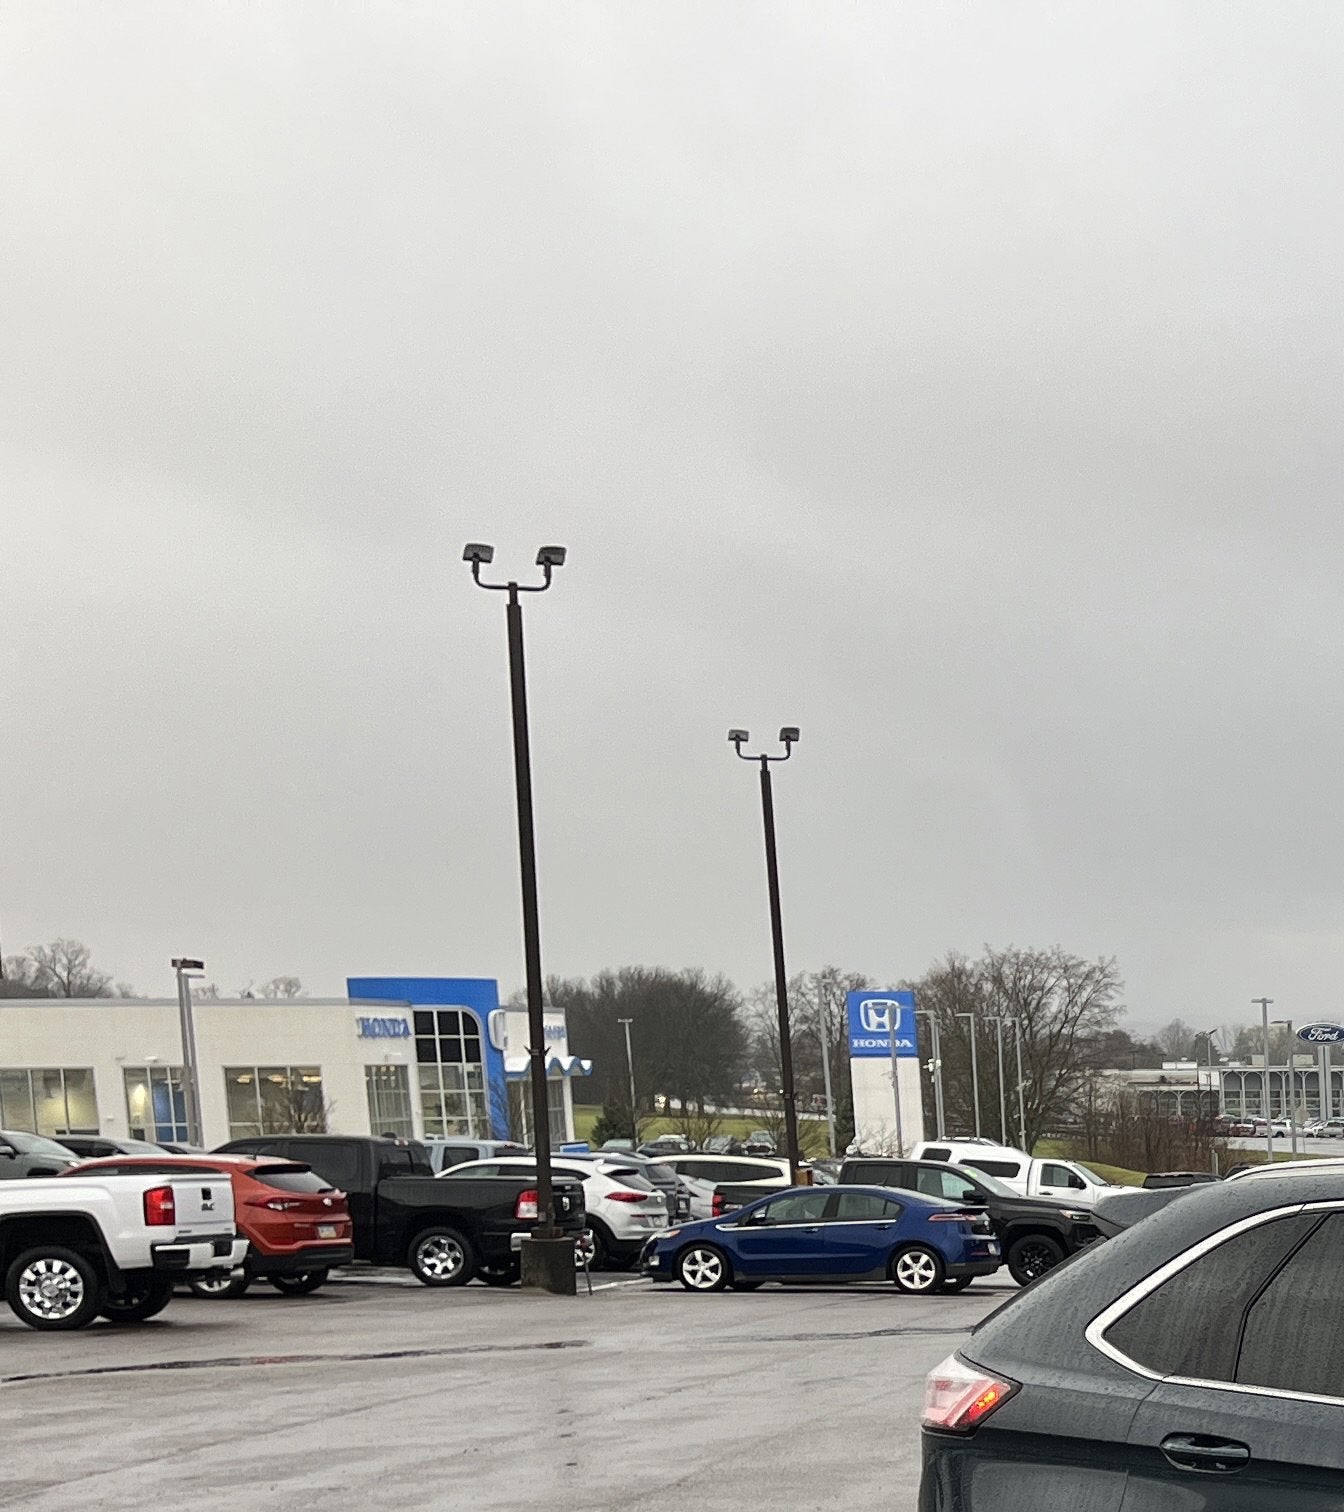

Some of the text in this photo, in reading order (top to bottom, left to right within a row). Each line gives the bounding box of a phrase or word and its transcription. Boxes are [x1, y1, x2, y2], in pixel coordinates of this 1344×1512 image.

[356, 1017, 411, 1038] HONDA
[1307, 1027, 1340, 1041] Ford
[852, 1039, 914, 1048] HONDA
